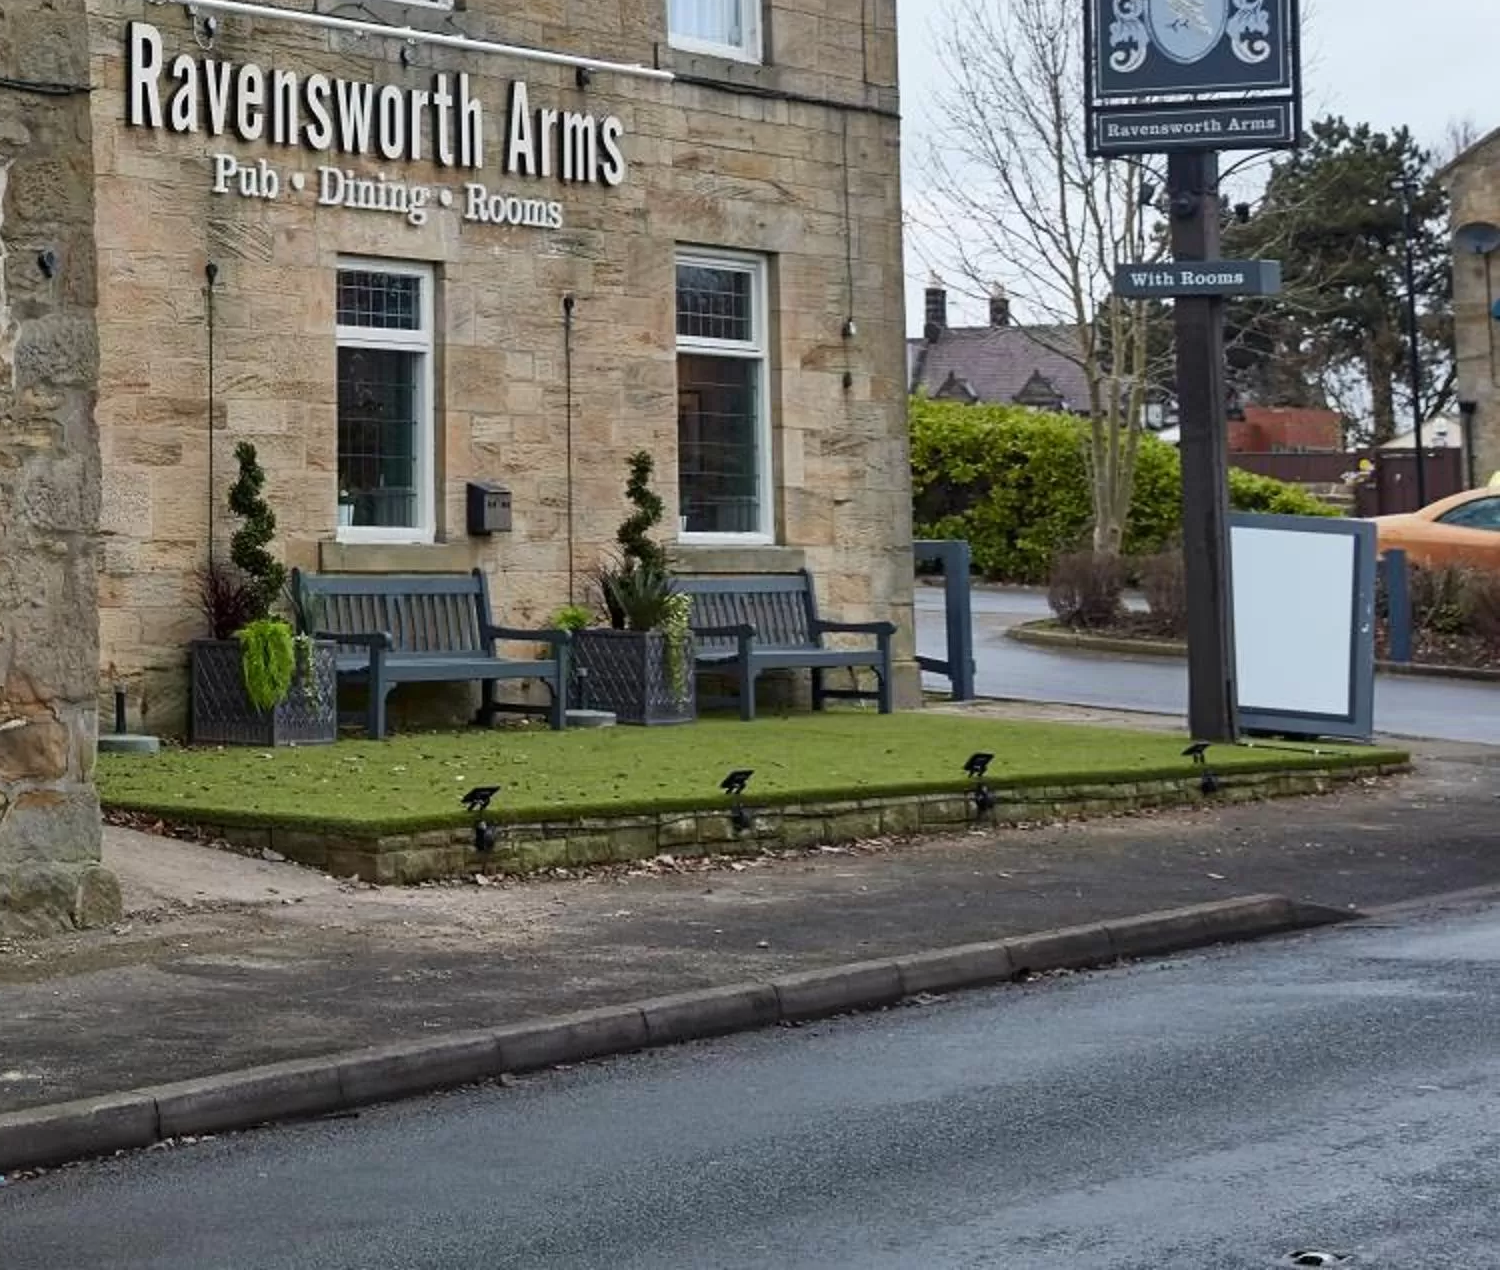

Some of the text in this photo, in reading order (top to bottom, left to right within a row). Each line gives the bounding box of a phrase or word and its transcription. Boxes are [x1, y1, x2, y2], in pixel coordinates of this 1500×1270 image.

[129, 20, 626, 186] Ravensworth Arms
[1107, 117, 1277, 138] Ravensworth Arms
[213, 153, 564, 230] Pub Dining Rooms
[1130, 271, 1245, 287] With Rooms
